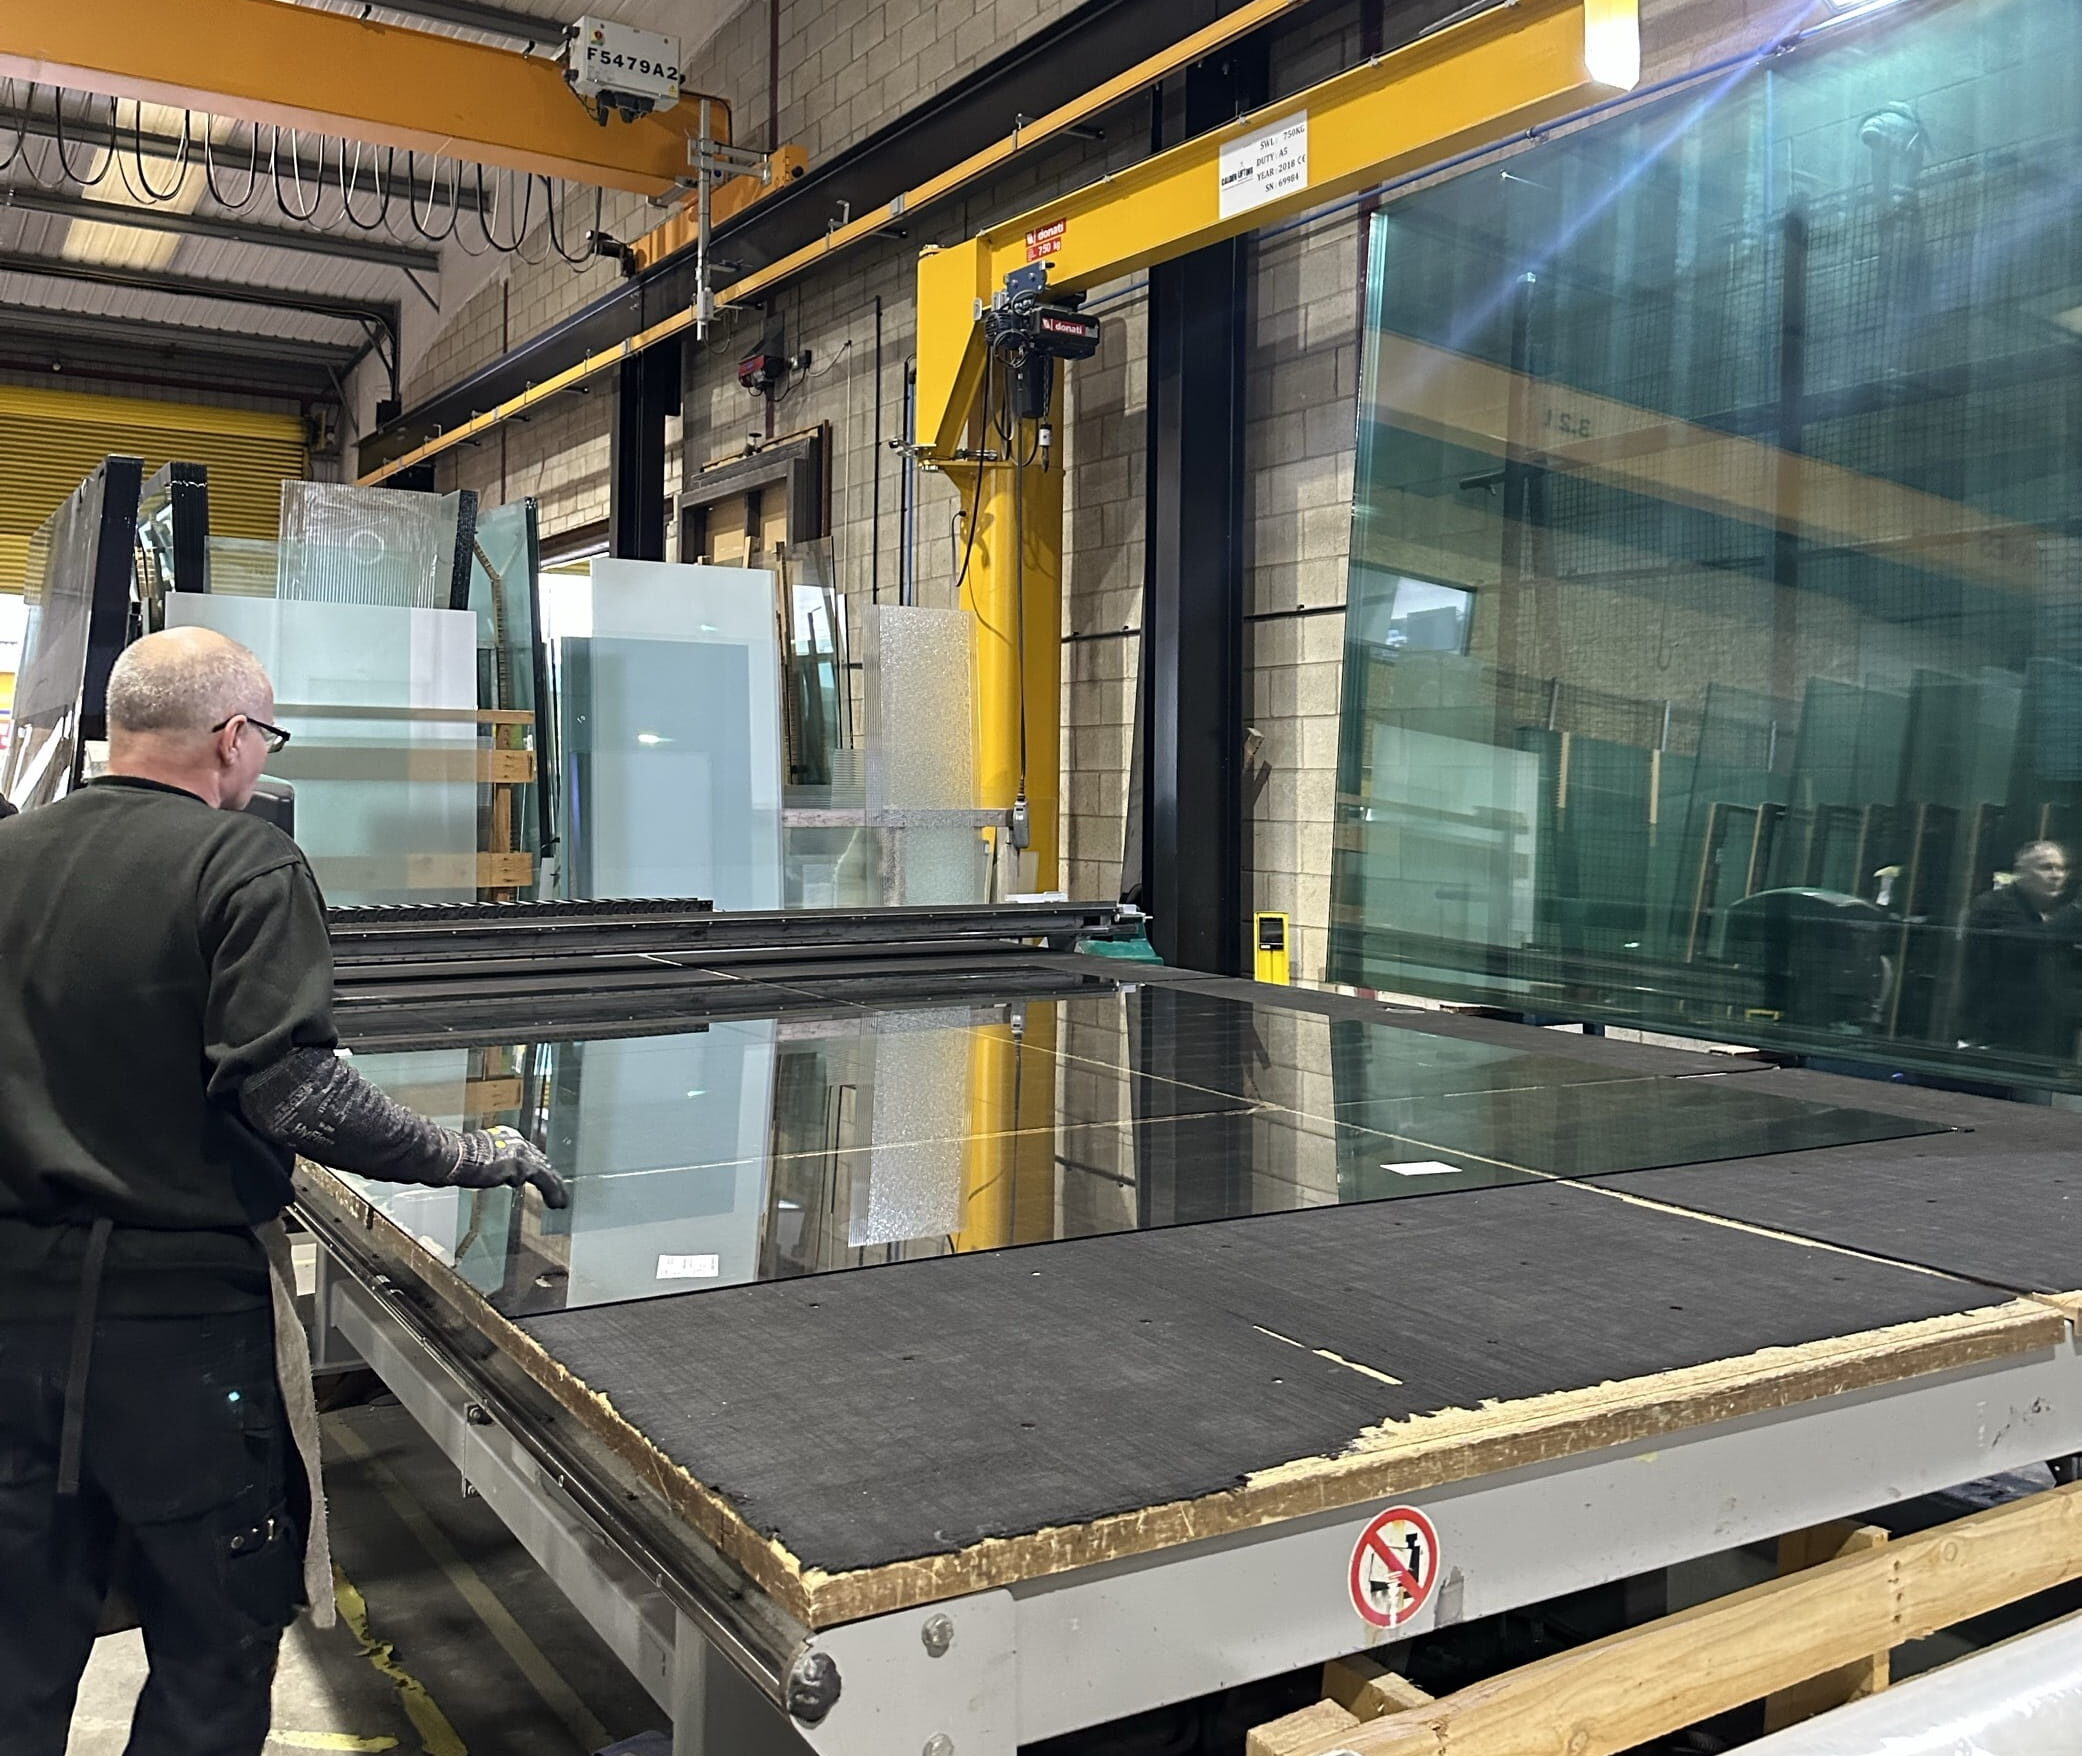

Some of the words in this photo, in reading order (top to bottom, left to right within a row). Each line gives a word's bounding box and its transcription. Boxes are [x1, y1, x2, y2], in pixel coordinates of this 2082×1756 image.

[587, 47, 679, 81] F5479A2
[1037, 221, 1064, 241] donati
[1038, 242, 1051, 257] 750
[1055, 321, 1082, 334] donati
